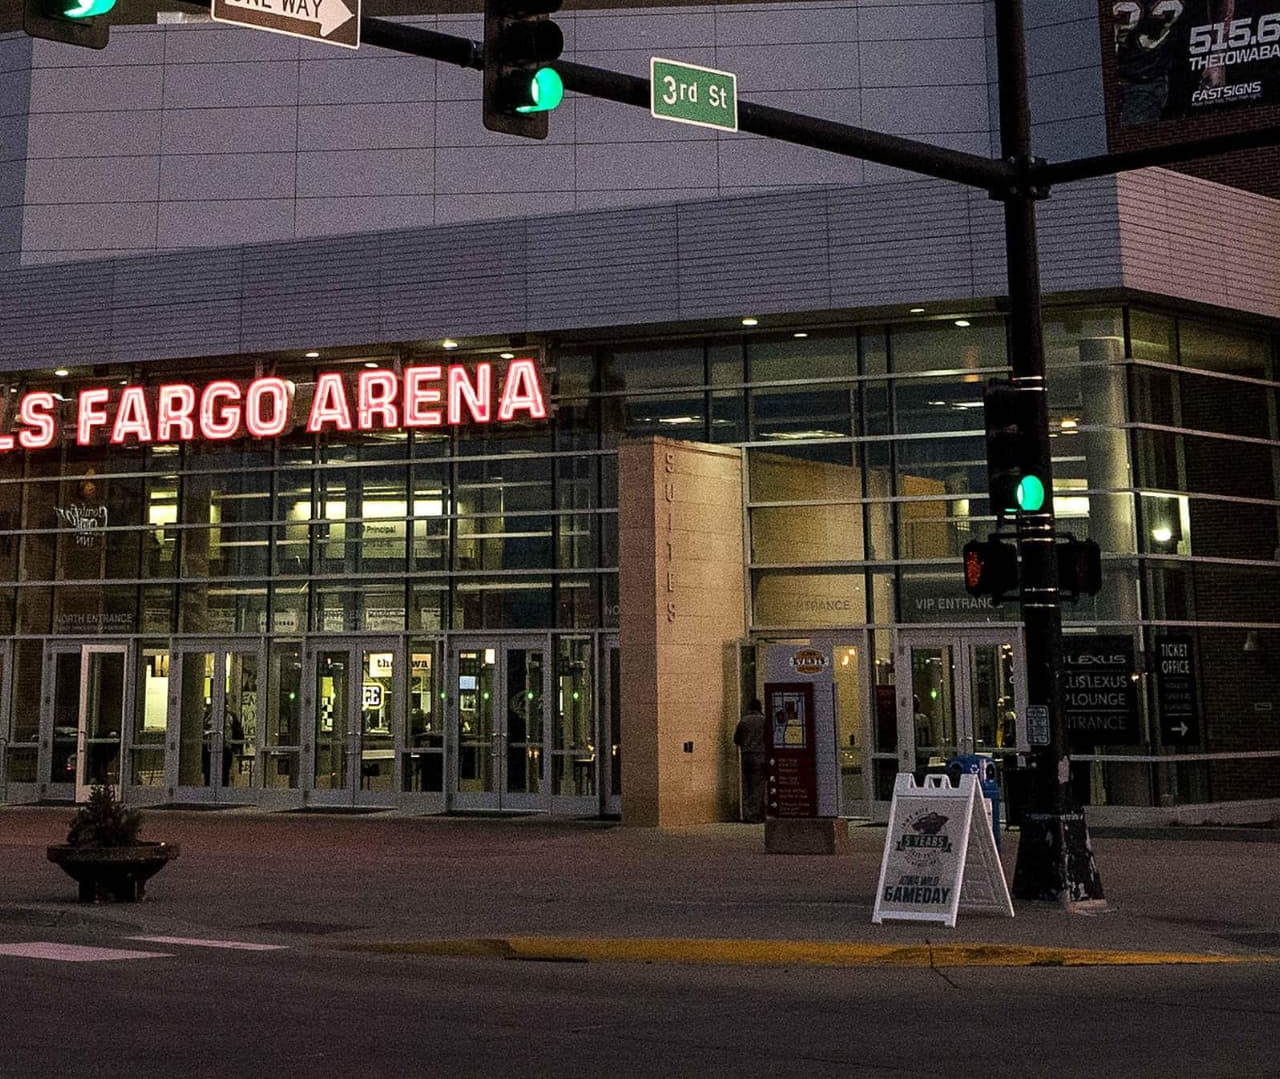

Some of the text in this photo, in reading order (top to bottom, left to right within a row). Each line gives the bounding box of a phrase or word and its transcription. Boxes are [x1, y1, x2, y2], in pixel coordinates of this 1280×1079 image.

[663, 75, 727, 109] 3rd St
[1192, 80, 1262, 102] FASTSIGNS
[76, 377, 294, 447] FARGO
[306, 358, 548, 433] ARENA
[665, 452, 676, 623] SUITES
[915, 598, 936, 610] VIP
[1161, 643, 1188, 658] TICKET
[377, 658, 392, 668] th
[1069, 654, 1127, 665] LEXUS
[1161, 660, 1190, 675] OFFICE
[1088, 676, 1128, 689] LEXUS
[1072, 693, 1127, 706] LOUNGE
[1067, 716, 1127, 730] TRANCE
[883, 886, 951, 904] GAMEDAY
